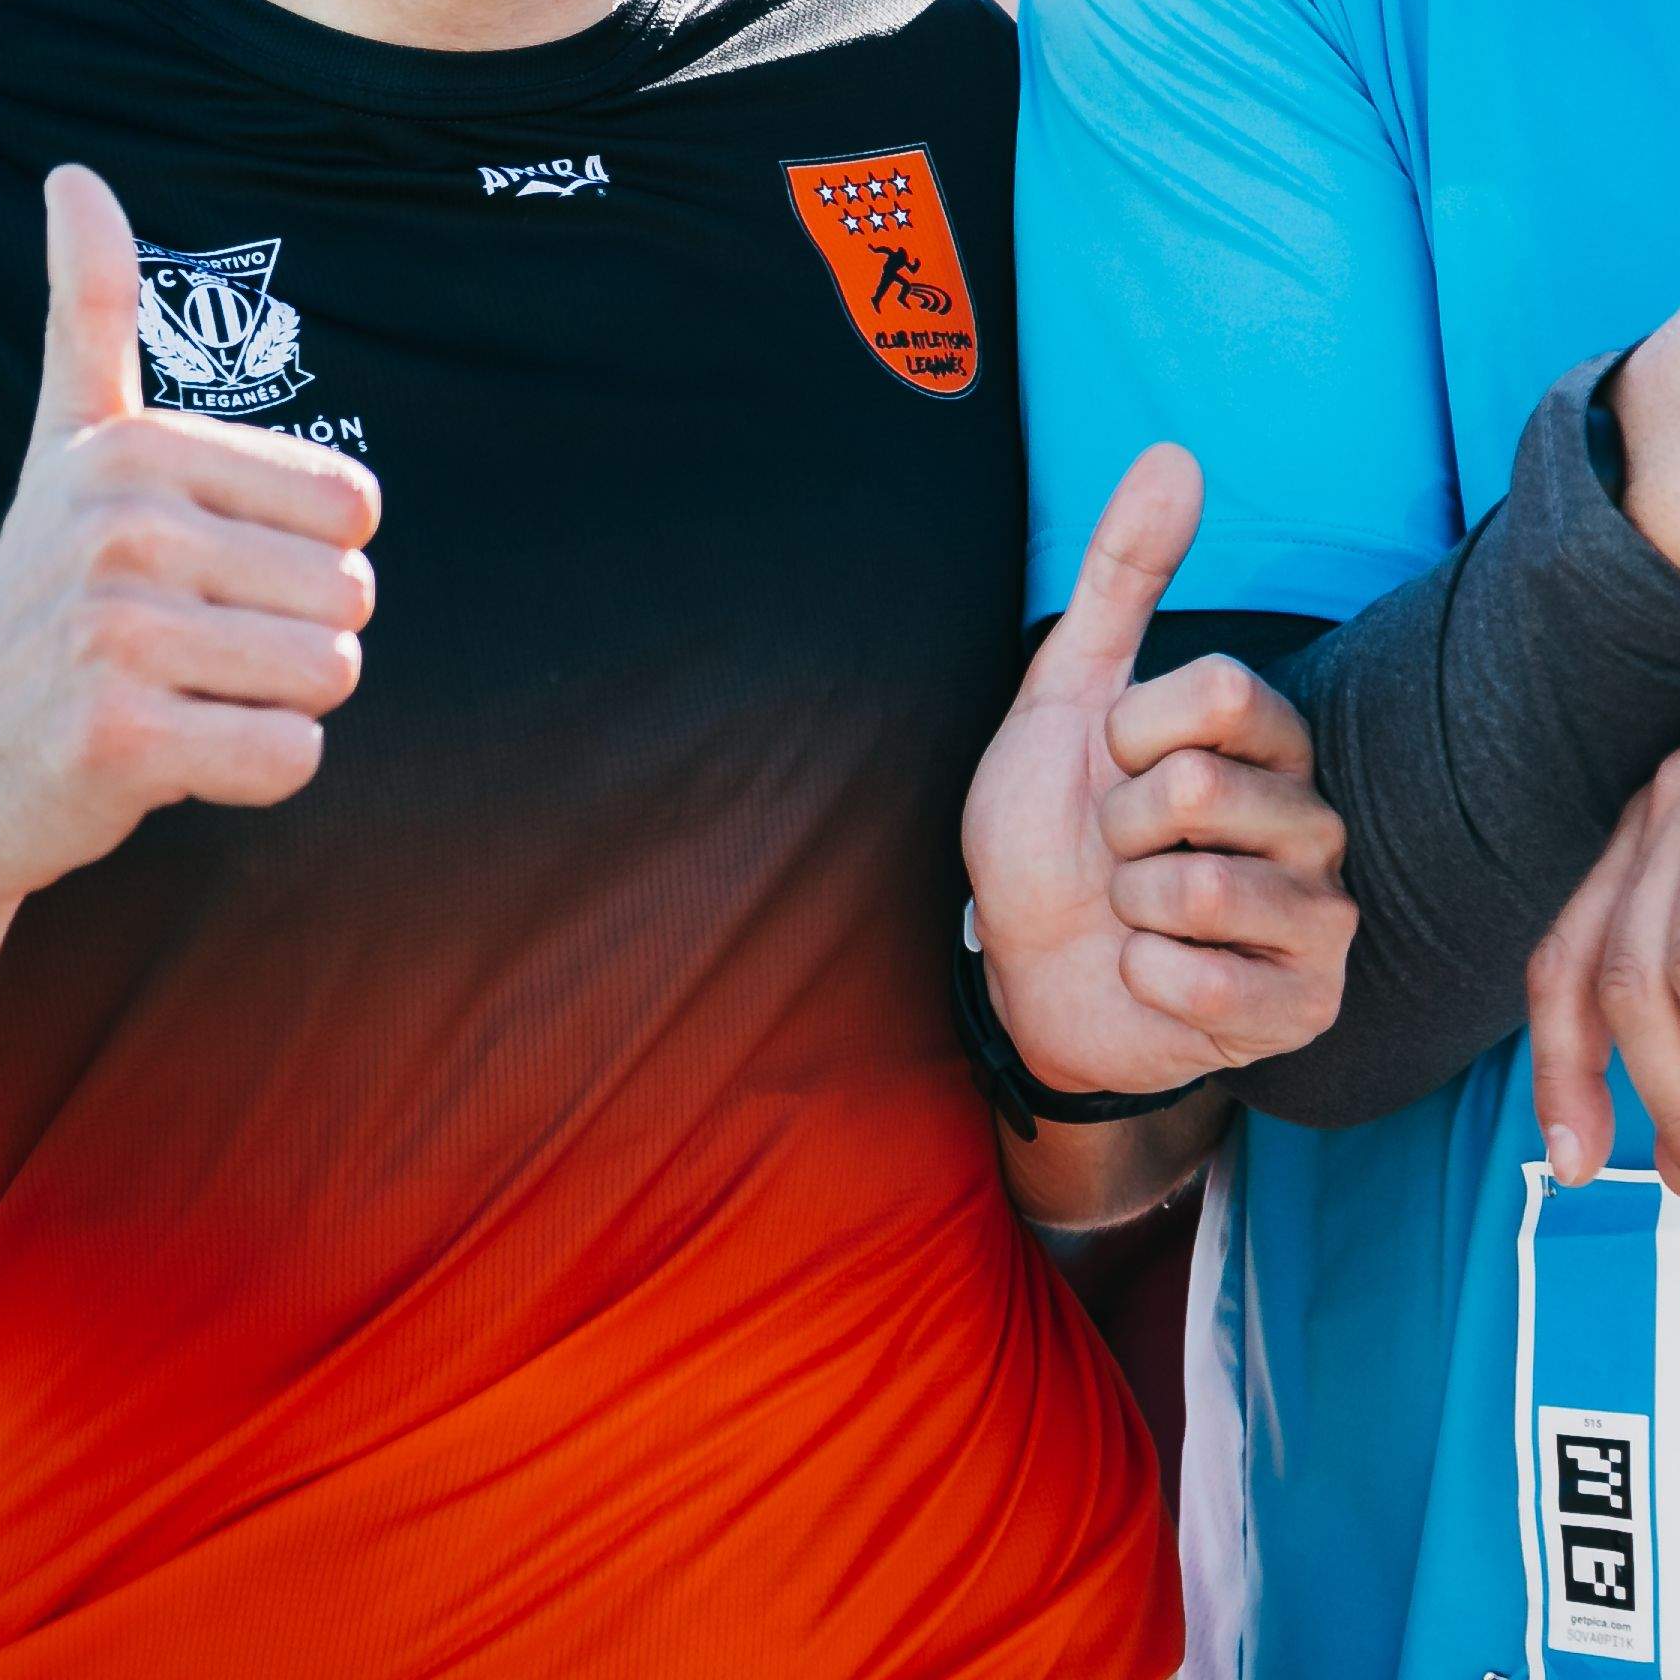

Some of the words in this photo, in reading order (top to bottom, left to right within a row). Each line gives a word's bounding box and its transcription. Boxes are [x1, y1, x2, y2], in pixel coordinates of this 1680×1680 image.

[193, 385, 280, 407] LEGANÉS
[1584, 1419, 1602, 1429] 515
[1571, 1616, 1632, 1632] getpica.com
